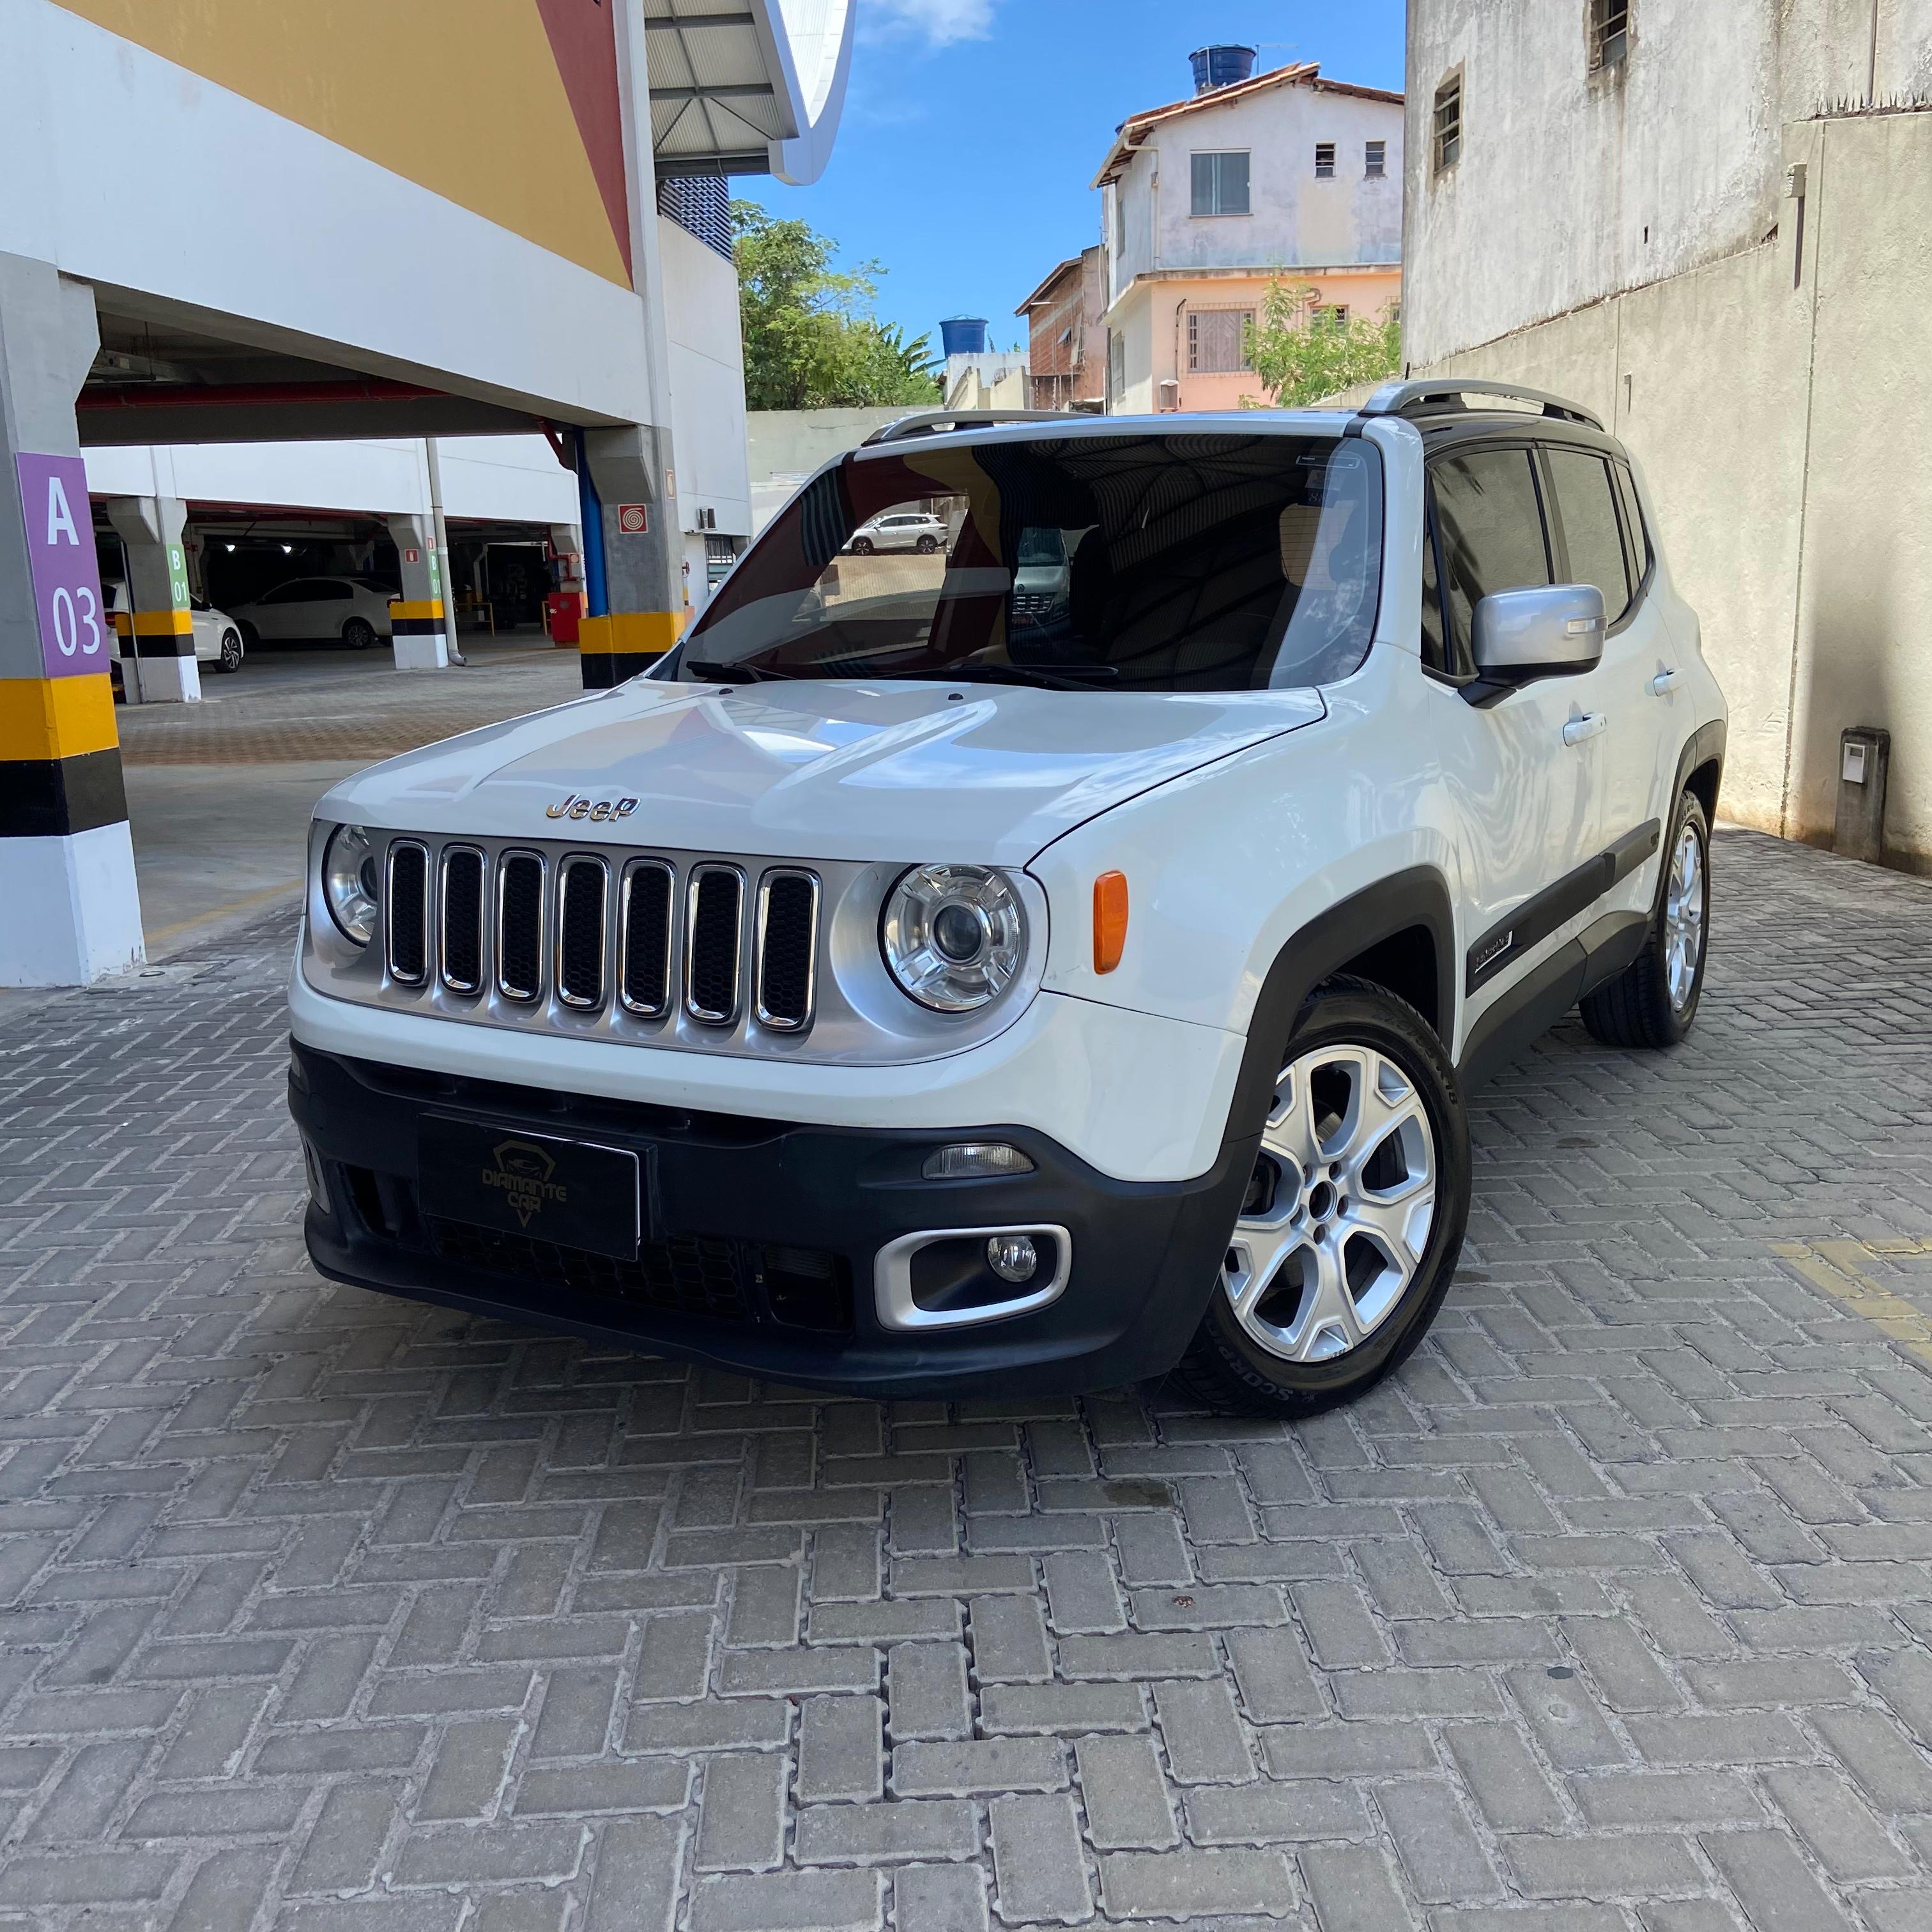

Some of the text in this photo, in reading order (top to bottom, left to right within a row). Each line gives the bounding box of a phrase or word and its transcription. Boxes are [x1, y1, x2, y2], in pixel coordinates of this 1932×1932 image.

[47, 477, 79, 545] A
[171, 549, 181, 571] B
[431, 555, 437, 571] B
[174, 581, 187, 602] 01
[53, 586, 100, 656] 03
[546, 795, 641, 822] Jeep
[482, 1169, 567, 1202] DIAMANTE
[508, 1192, 541, 1213] CAR
